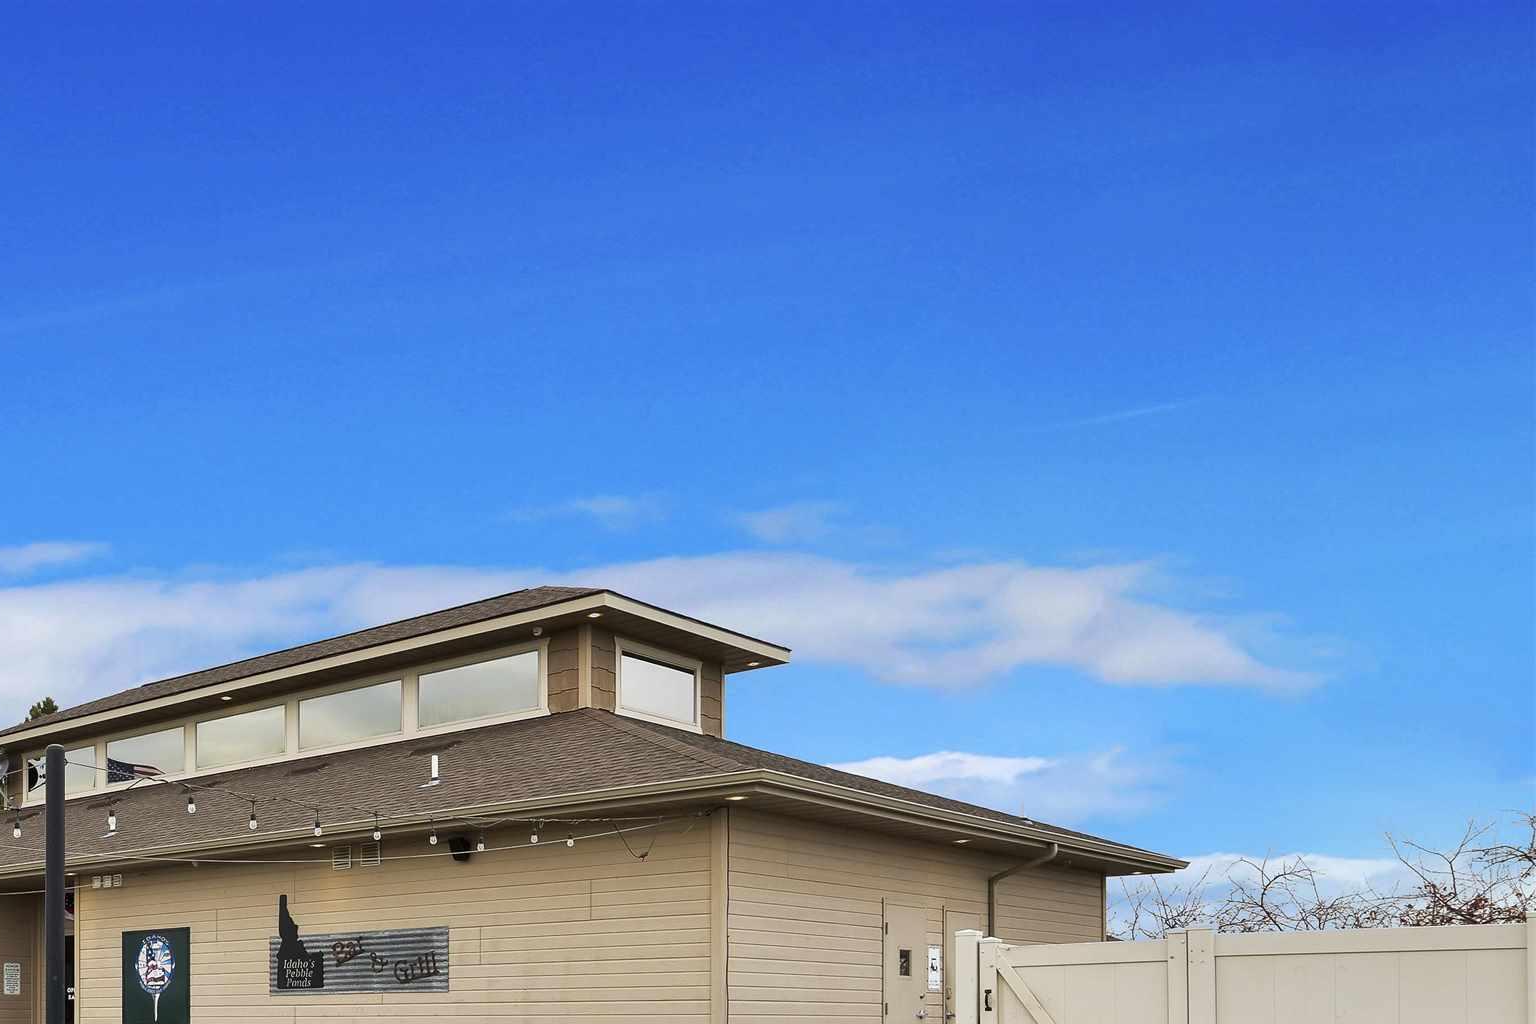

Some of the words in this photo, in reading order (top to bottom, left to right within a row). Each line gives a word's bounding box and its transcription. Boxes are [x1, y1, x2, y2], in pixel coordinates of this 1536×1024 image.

[283, 958, 315, 969] Idaho's
[370, 952, 389, 973] &
[394, 951, 441, 983] Grill
[285, 968, 313, 978] Pebble
[286, 977, 312, 987] Ponds
